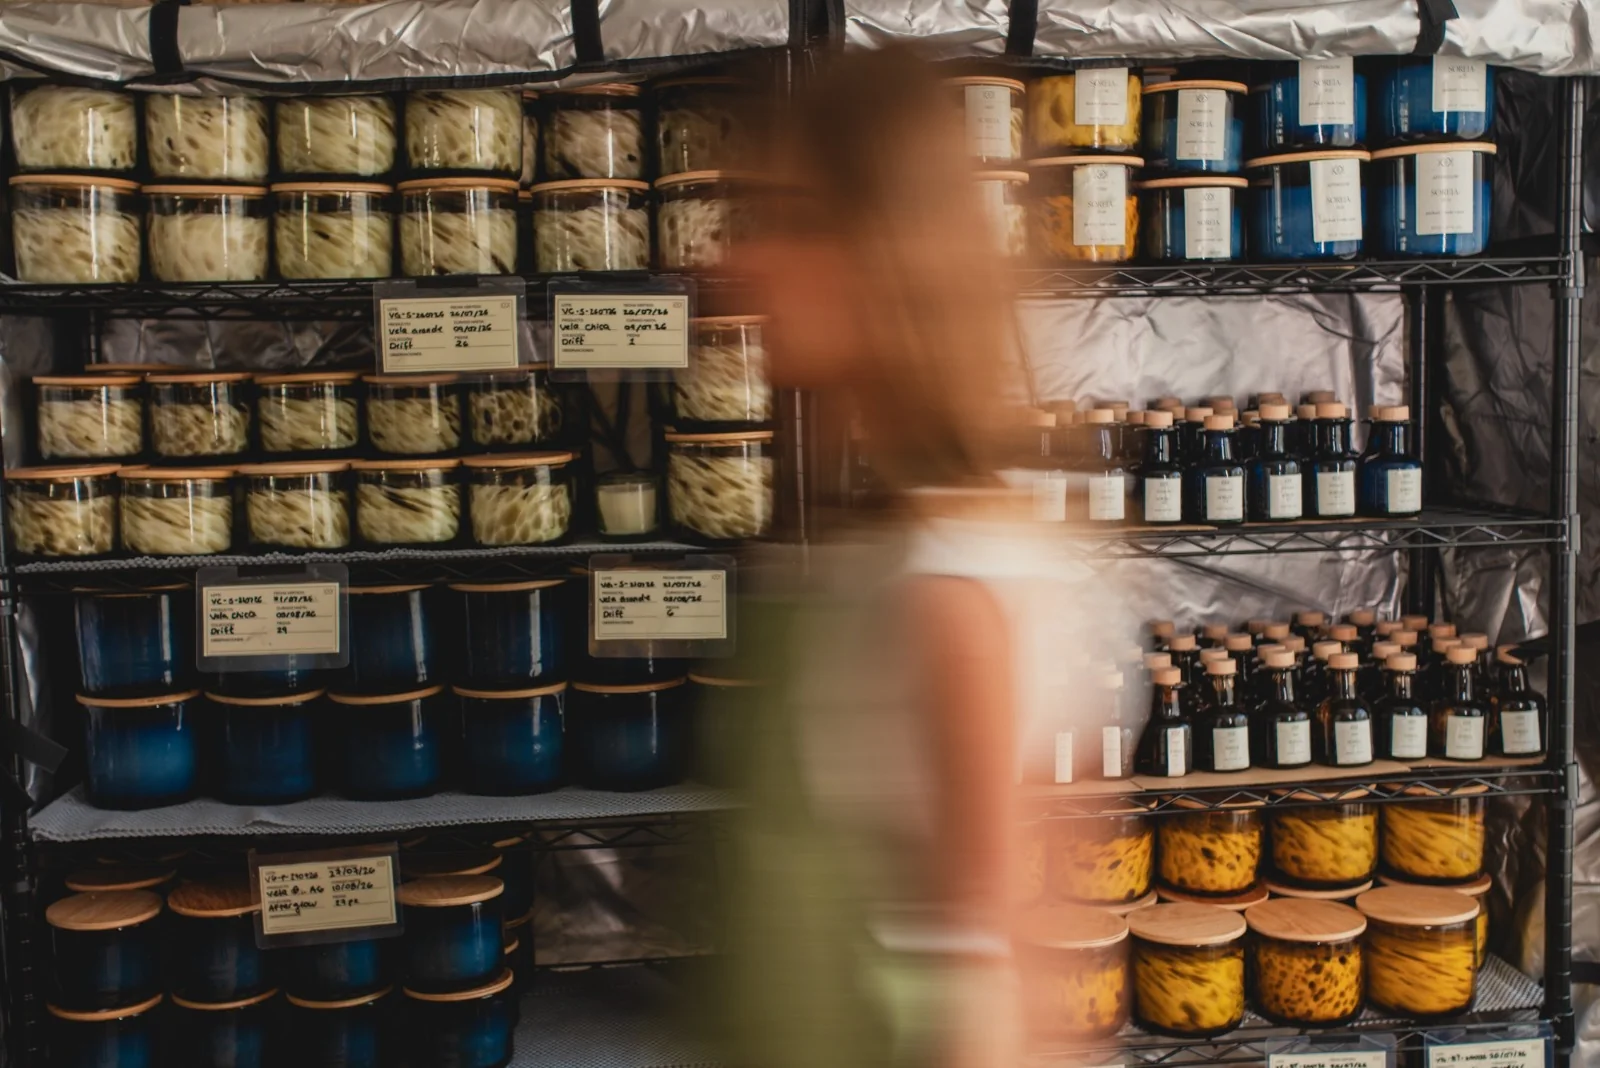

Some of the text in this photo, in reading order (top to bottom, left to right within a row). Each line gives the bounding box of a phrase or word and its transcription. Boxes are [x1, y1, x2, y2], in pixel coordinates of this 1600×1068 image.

[1448, 65, 1475, 73] SOREIA
[1313, 79, 1341, 87] SOREIA
[455, 340, 469, 348] 26
[562, 337, 585, 345] Drift
[389, 341, 413, 350] Drift
[603, 610, 623, 618] Drift
[211, 627, 234, 635] Drift
[329, 866, 375, 878] 27/07/26
